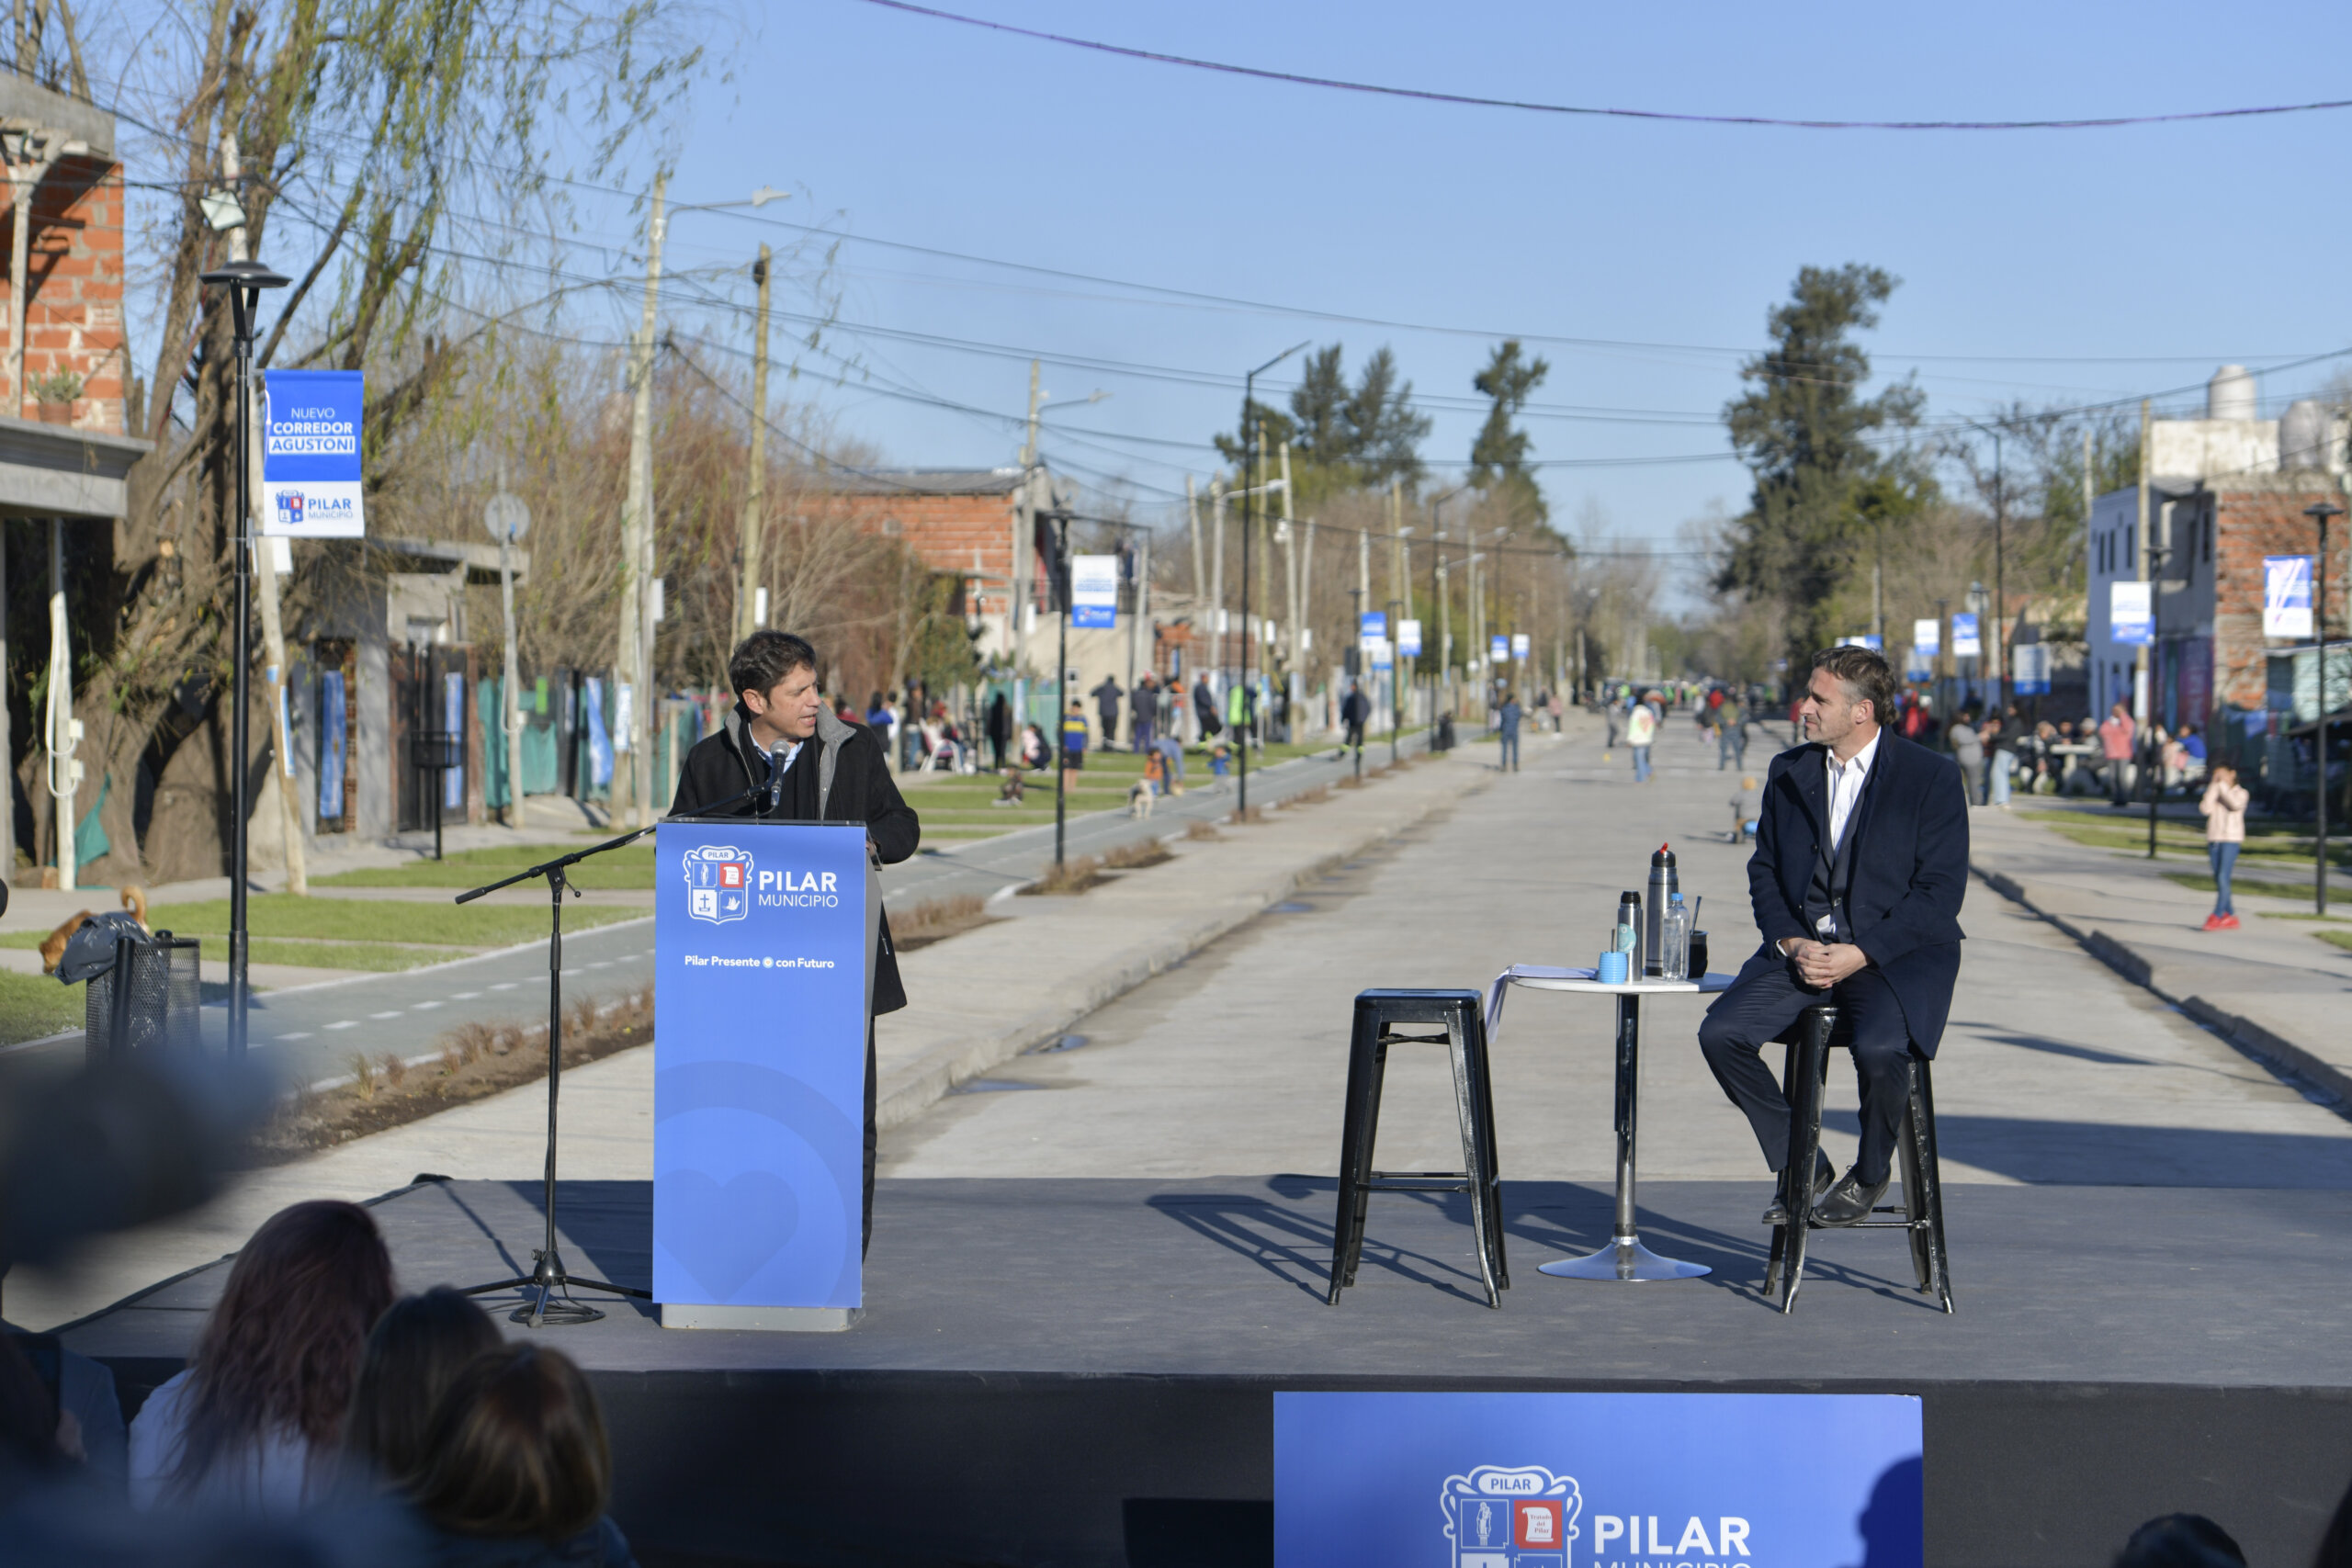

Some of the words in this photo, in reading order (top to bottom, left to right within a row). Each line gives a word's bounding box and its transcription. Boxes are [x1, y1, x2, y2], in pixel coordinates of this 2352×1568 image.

[290, 408, 335, 419] NUEVO
[273, 422, 354, 434] CORREDOR
[271, 438, 354, 451] AGUSTONI
[308, 498, 352, 510] PILAR
[308, 511, 354, 520] MUNICIPIO
[758, 871, 838, 892] PILAR
[758, 894, 839, 908] MUNICIPIO
[684, 955, 709, 966] Pilar
[711, 955, 761, 967] Presente
[775, 959, 796, 968] con
[797, 957, 835, 969] Futuro
[1490, 1478, 1532, 1490] PILAR
[1594, 1515, 1751, 1556] PILAR
